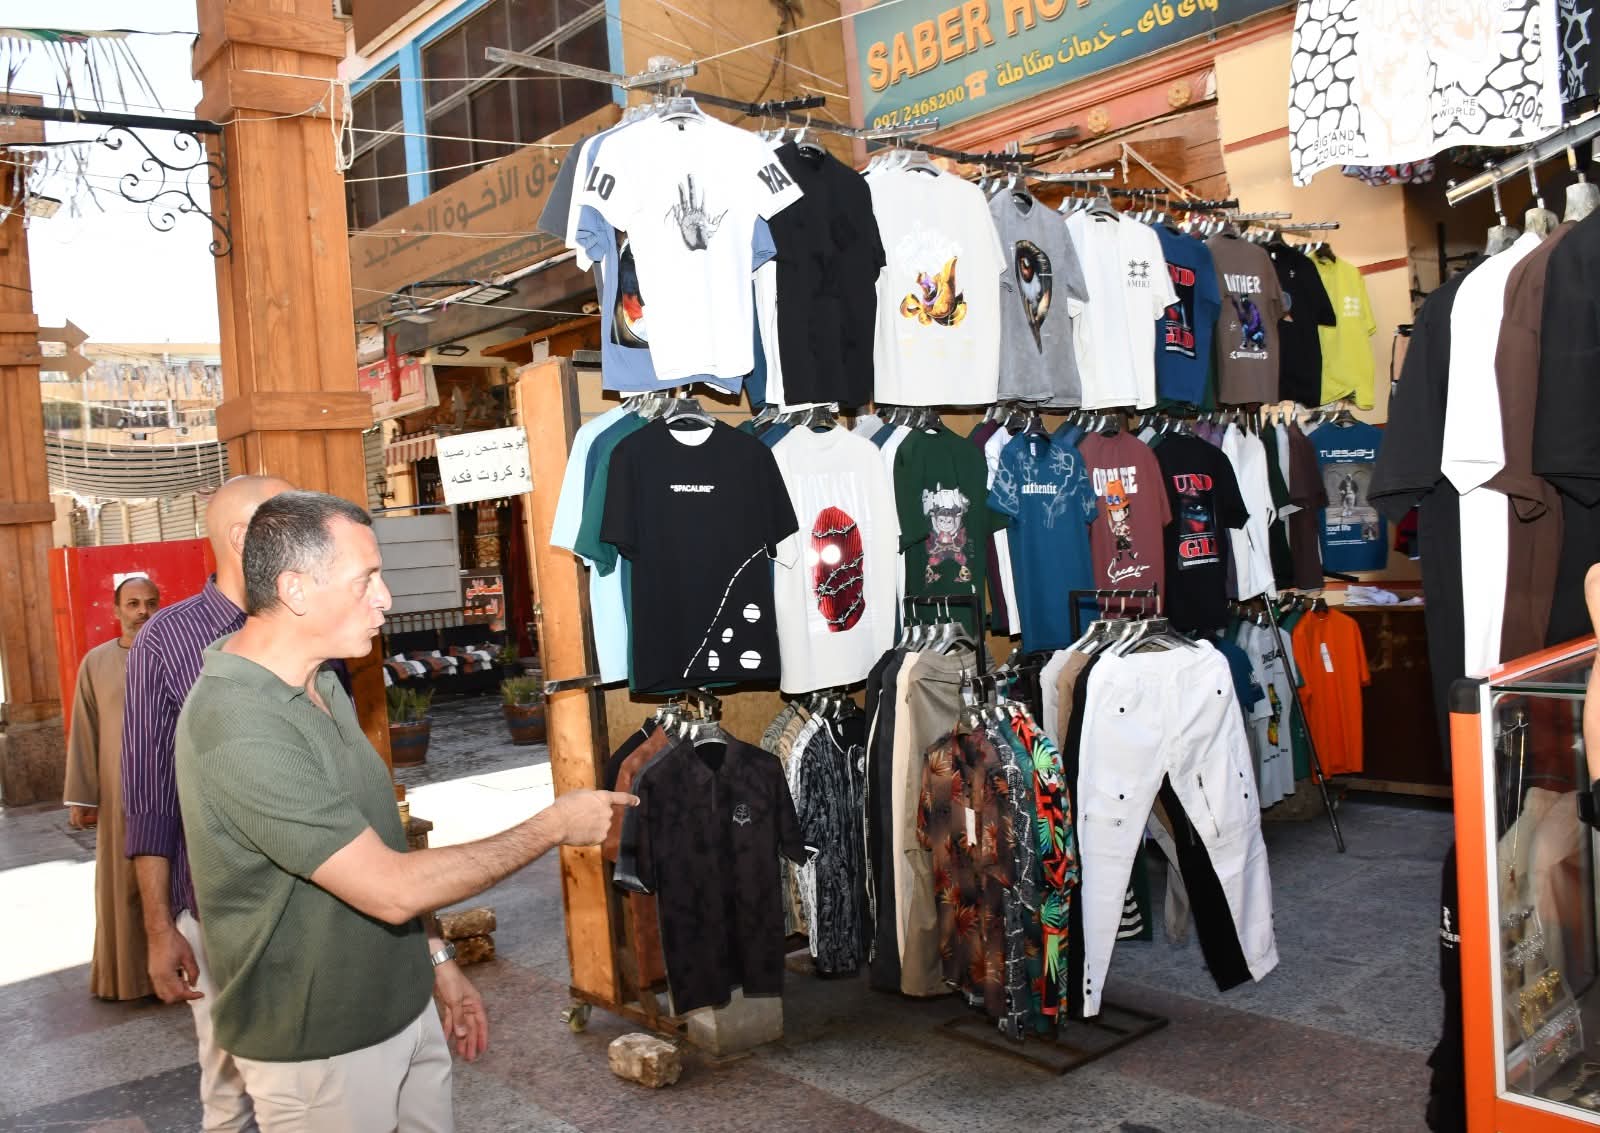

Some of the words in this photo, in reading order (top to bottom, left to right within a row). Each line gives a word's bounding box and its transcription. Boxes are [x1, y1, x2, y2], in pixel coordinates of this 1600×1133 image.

[867, 0, 995, 92] SABER
[1057, 22, 1116, 64] خدمات
[996, 48, 1055, 88] متكاملة
[477, 465, 513, 482] كروت
